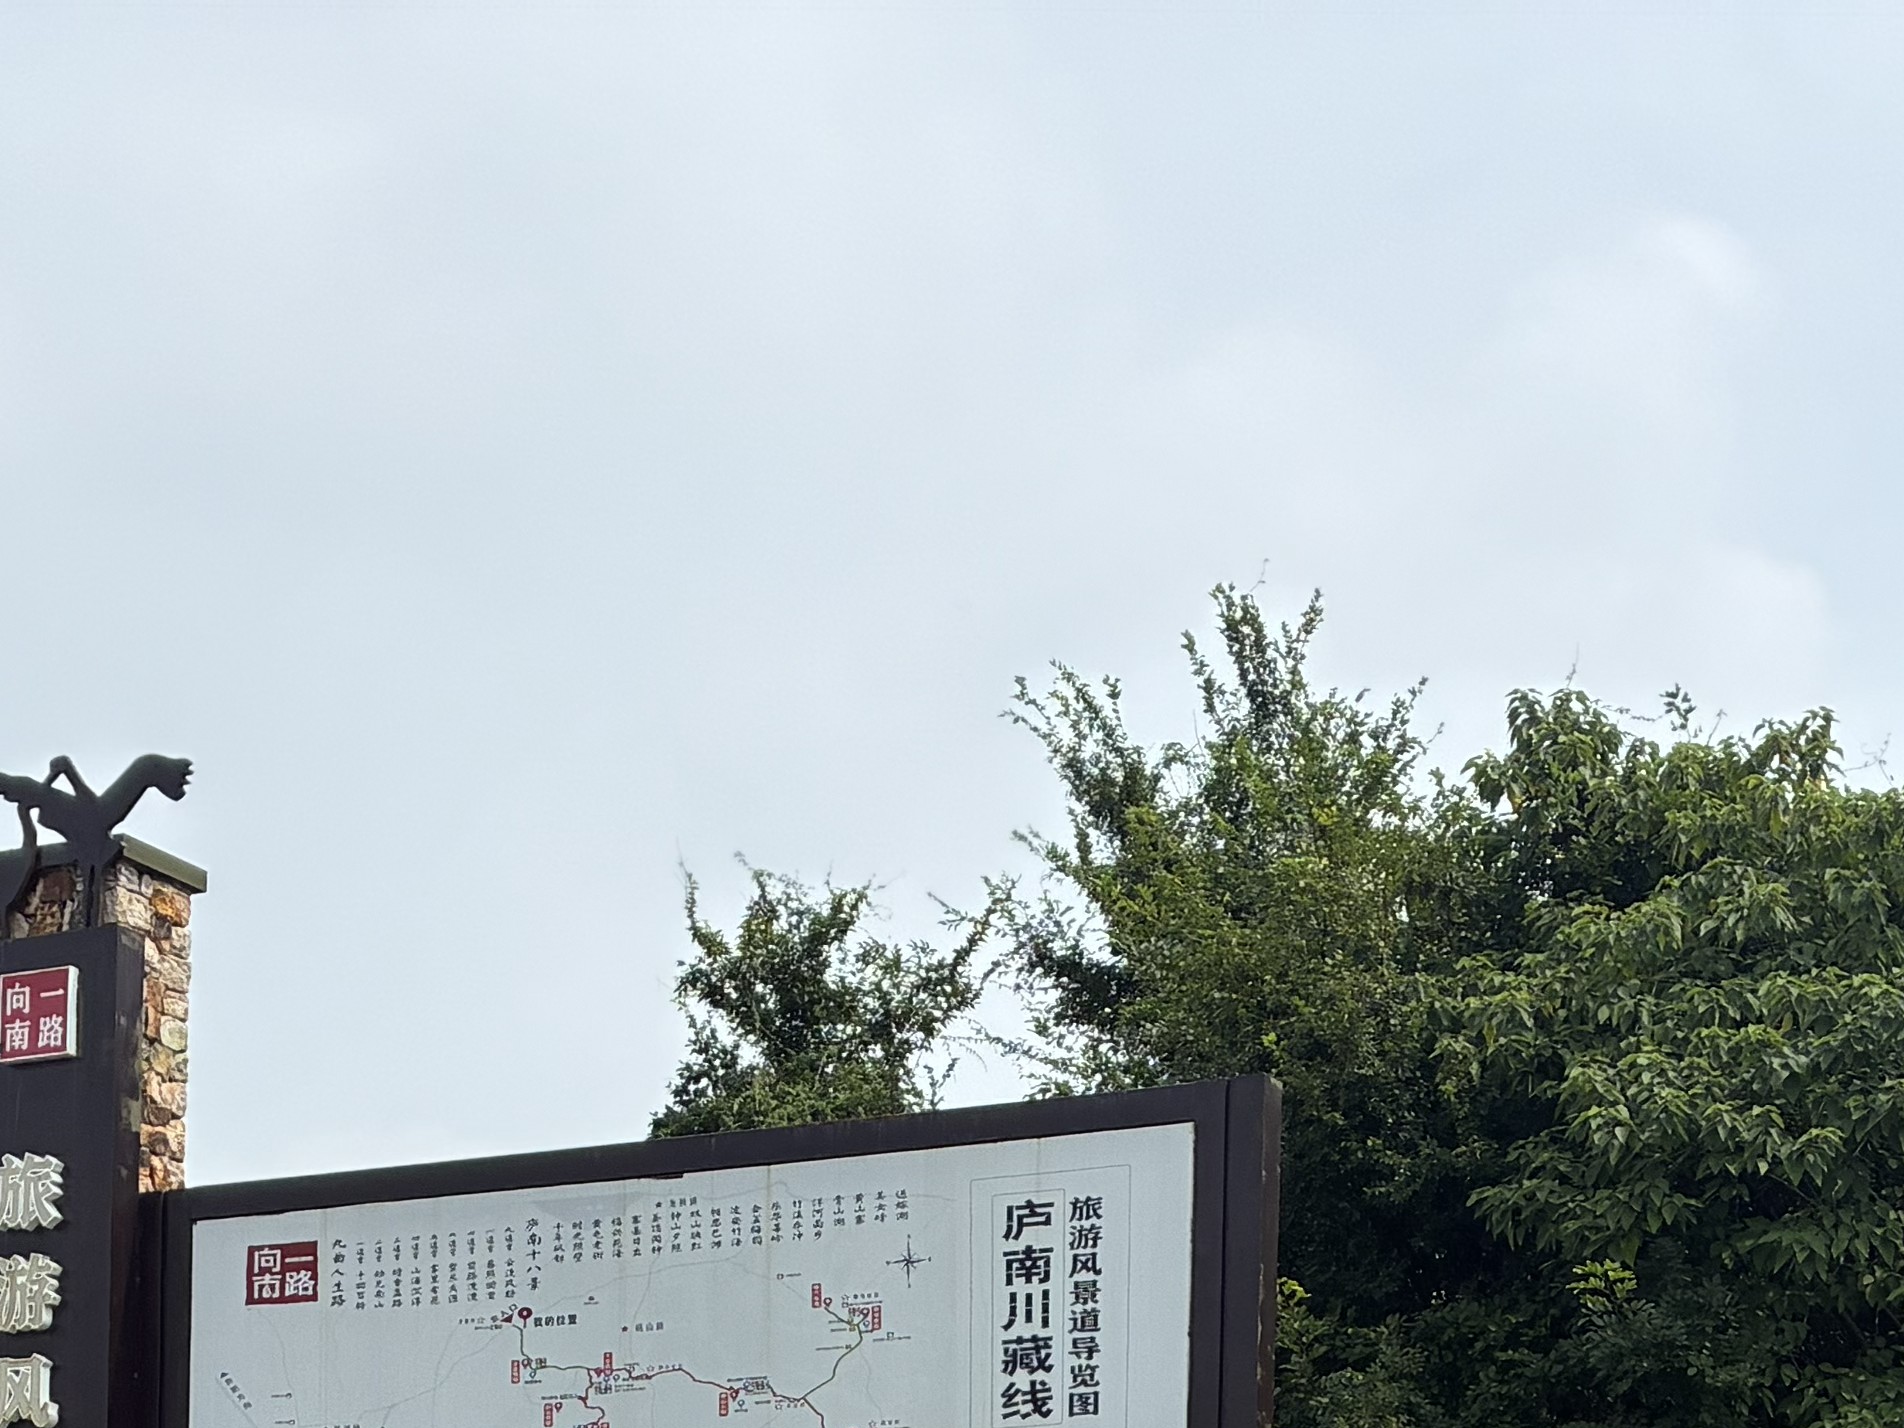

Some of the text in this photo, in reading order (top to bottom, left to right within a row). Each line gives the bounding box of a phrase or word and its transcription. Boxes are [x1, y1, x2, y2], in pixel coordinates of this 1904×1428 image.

[5, 982, 31, 1052] 向南
[38, 983, 64, 1048] 一路
[252, 1247, 283, 1299] 向南
[284, 1255, 316, 1297] 一路
[534, 1314, 578, 1328] 我的位置
[1000, 1199, 1055, 1420] 庐南川藏线
[1067, 1196, 1104, 1418] 旅游风景道导览图
